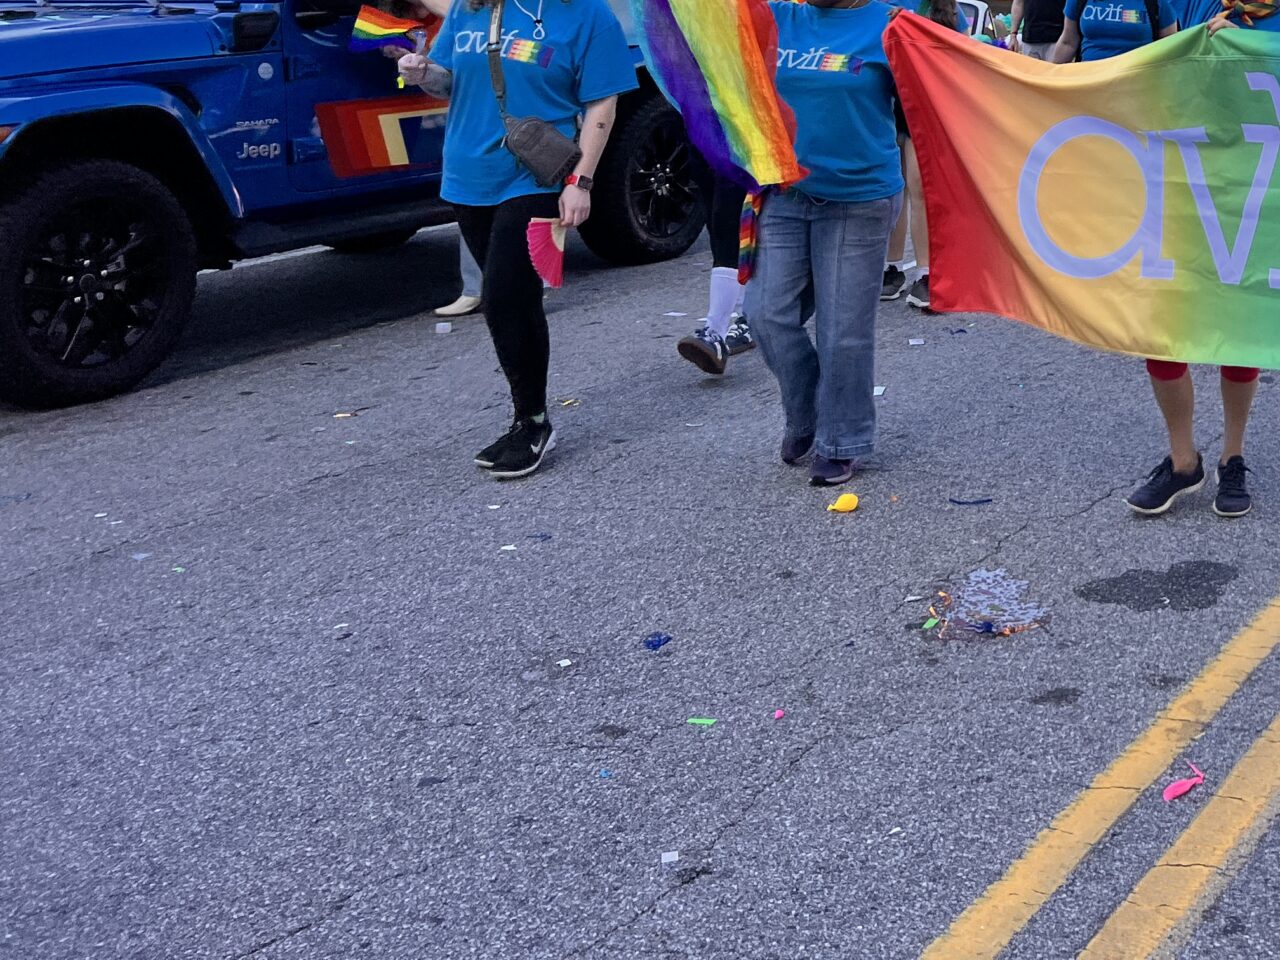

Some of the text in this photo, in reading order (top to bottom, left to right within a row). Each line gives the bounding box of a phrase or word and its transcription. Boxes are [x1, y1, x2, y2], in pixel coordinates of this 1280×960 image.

[1082, 4, 1123, 22] avlf
[455, 29, 519, 58] avf
[236, 118, 280, 128] SAHARA
[236, 142, 281, 159] Jeep
